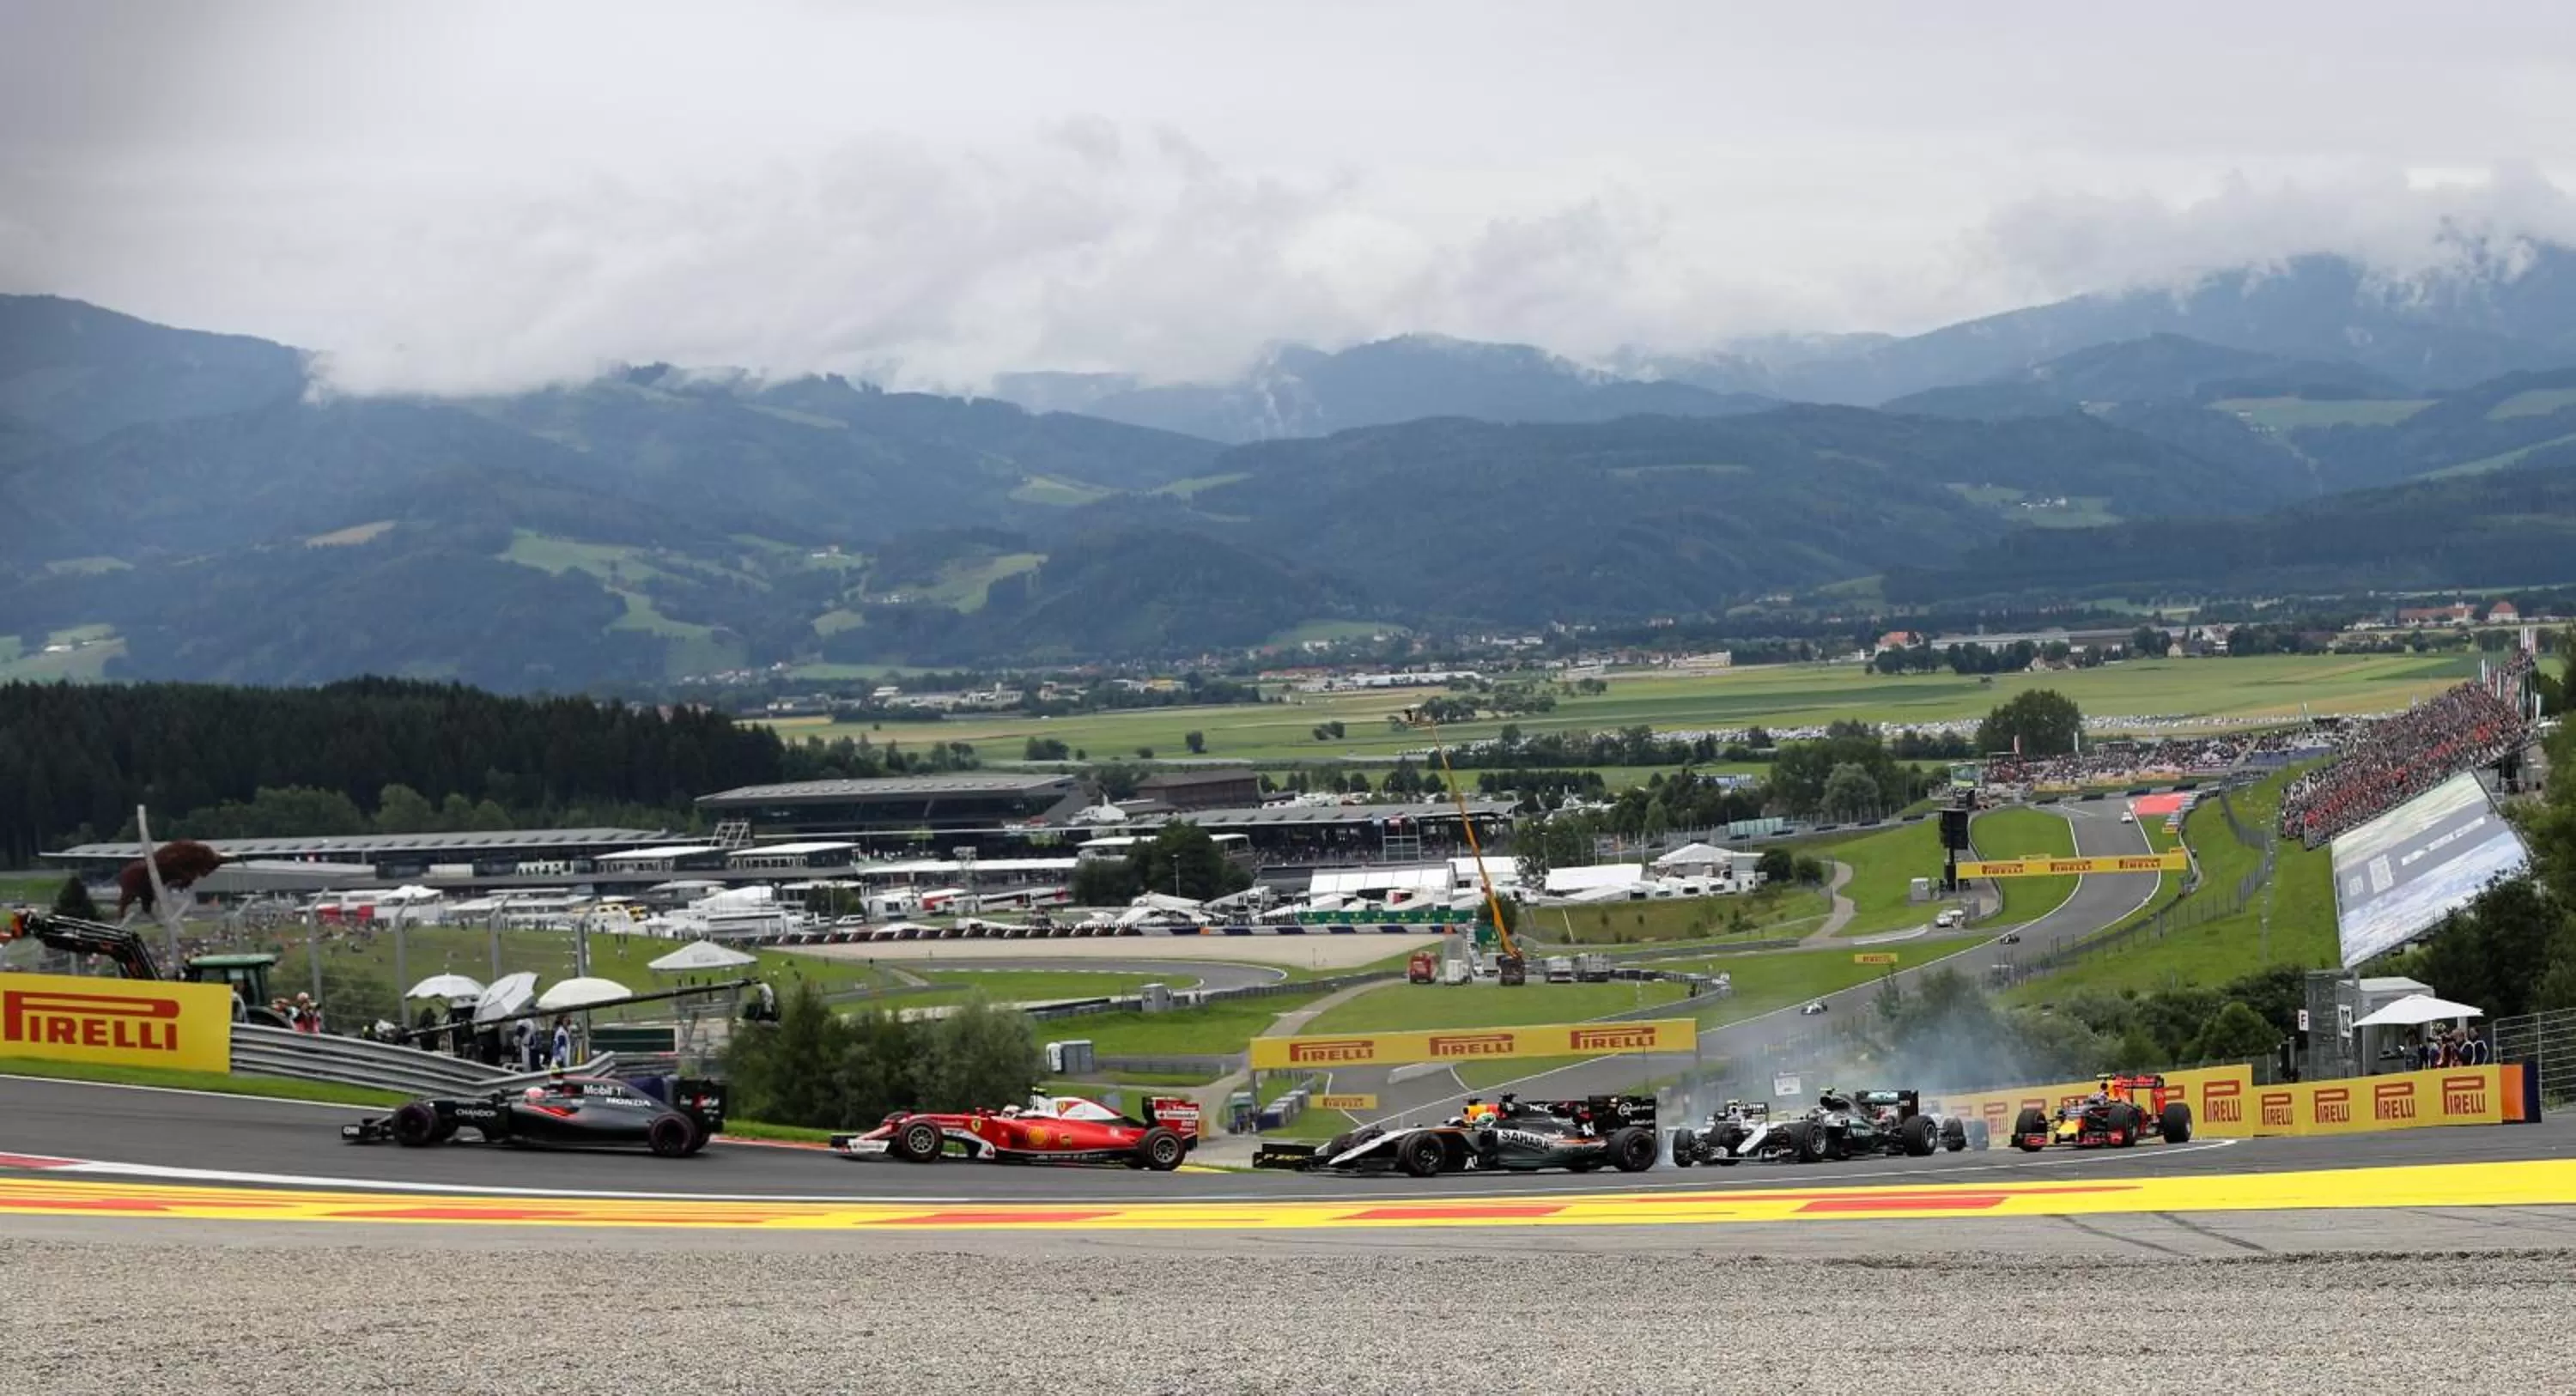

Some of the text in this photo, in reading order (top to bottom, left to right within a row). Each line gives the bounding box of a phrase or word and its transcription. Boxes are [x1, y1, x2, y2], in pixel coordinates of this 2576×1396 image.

[4, 991, 180, 1050] PIRELLI
[1290, 1027, 1656, 1062] PIRELLI PIRELLI PIRELLI
[584, 1085, 612, 1096] Mobil
[606, 1097, 652, 1107] HONDA
[2203, 1079, 2241, 1123] PIRELLI
[2262, 1075, 2486, 1126] PIRELLI PIRELLI PIRELLI PIRELLI
[1529, 1103, 1553, 1114] NEC
[1502, 1131, 1552, 1151] SAHARA
